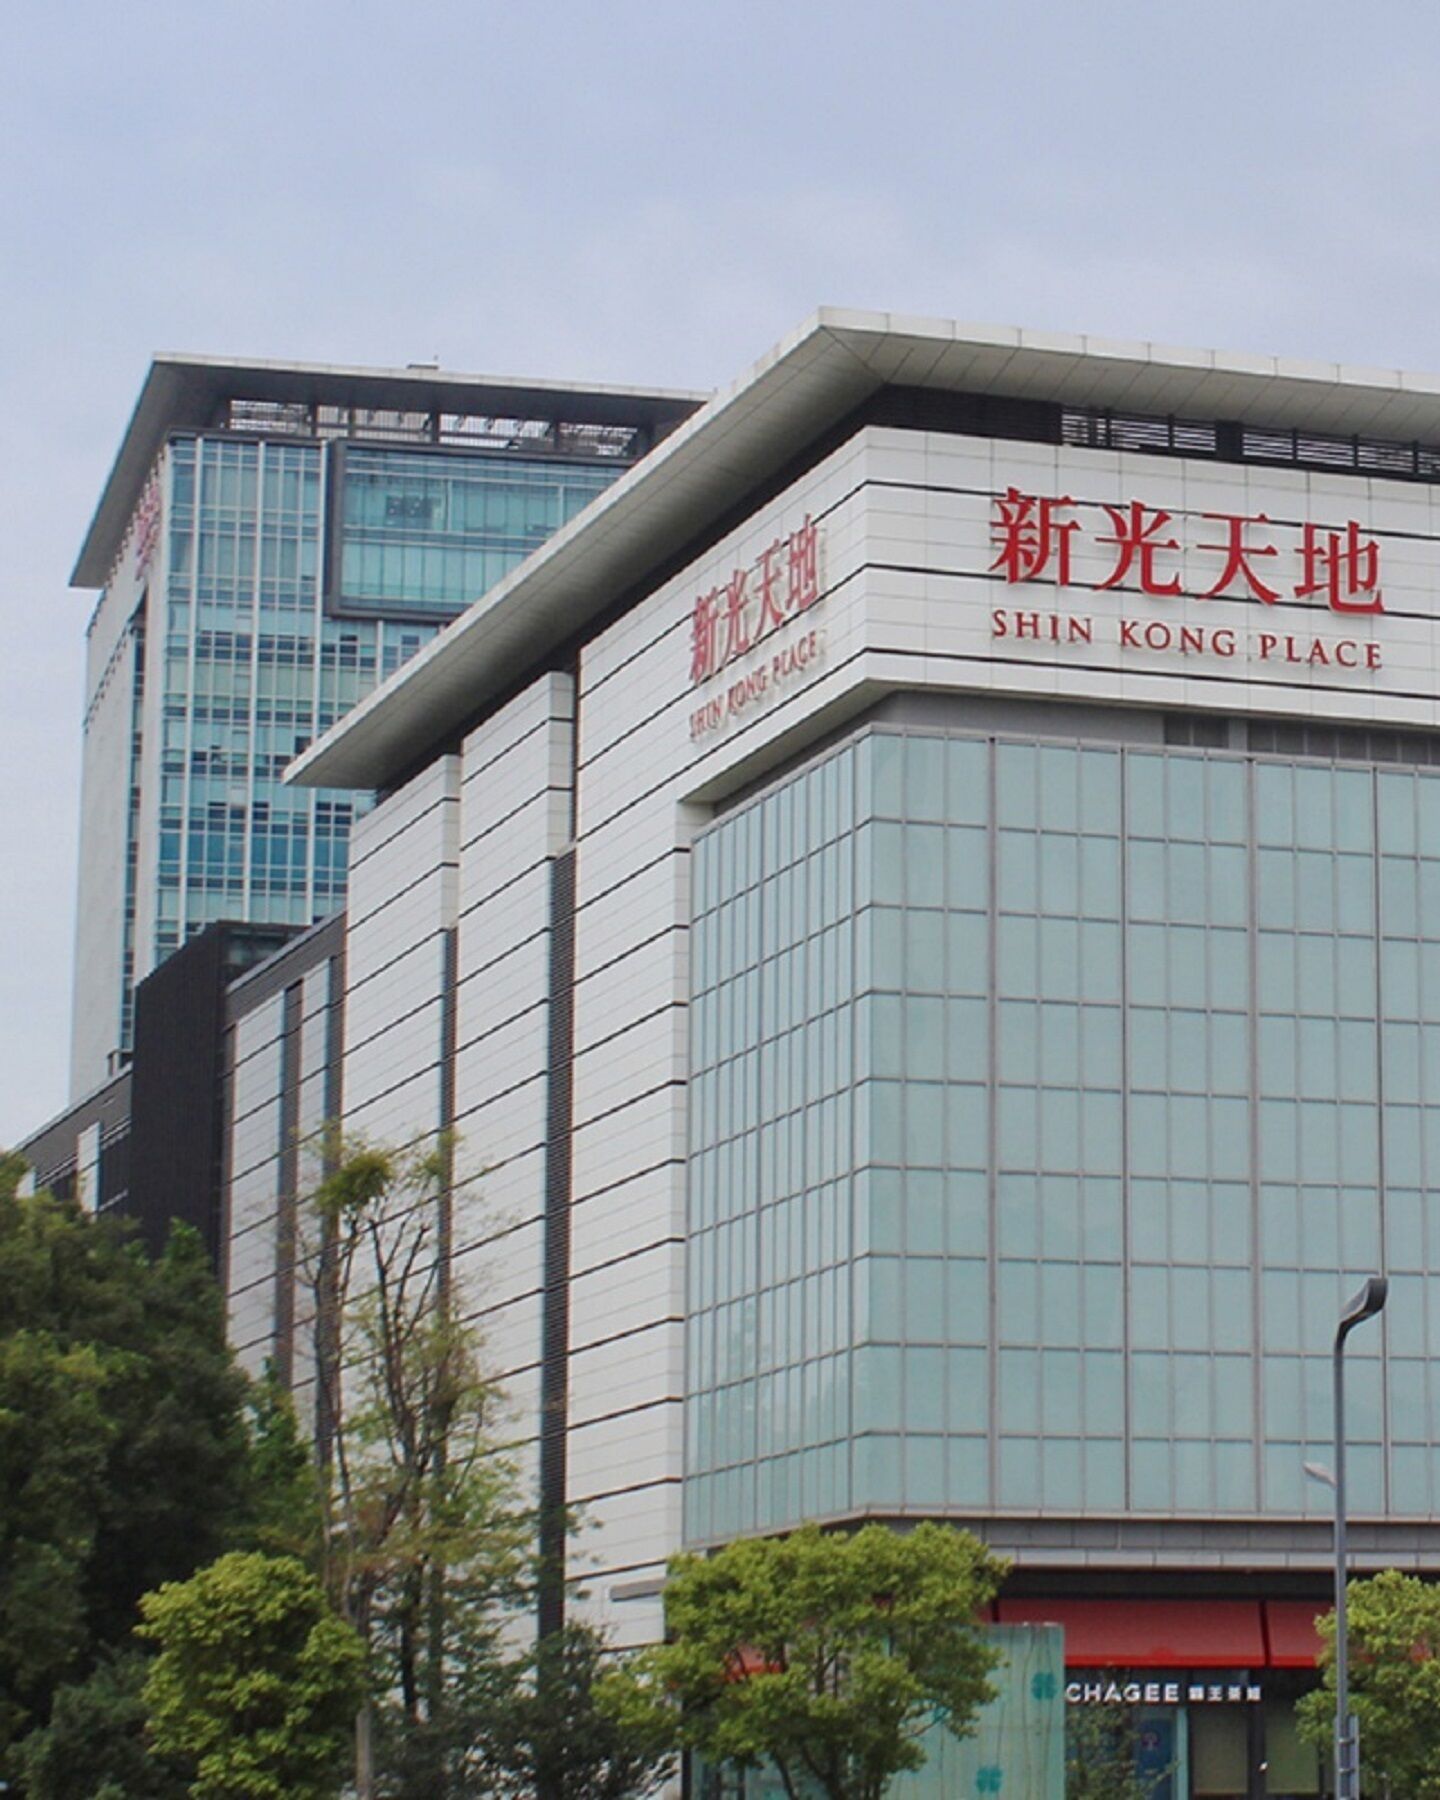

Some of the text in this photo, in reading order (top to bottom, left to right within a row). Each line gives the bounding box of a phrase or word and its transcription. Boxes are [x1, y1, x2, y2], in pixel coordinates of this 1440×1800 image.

[689, 513, 819, 684] 新光天地
[989, 487, 1384, 615] 新光天地
[690, 631, 817, 737] SHIN KONG PLACE
[992, 609, 1383, 670] SHIN KONG PLACE
[1065, 1682, 1179, 1702] CHAGEE
